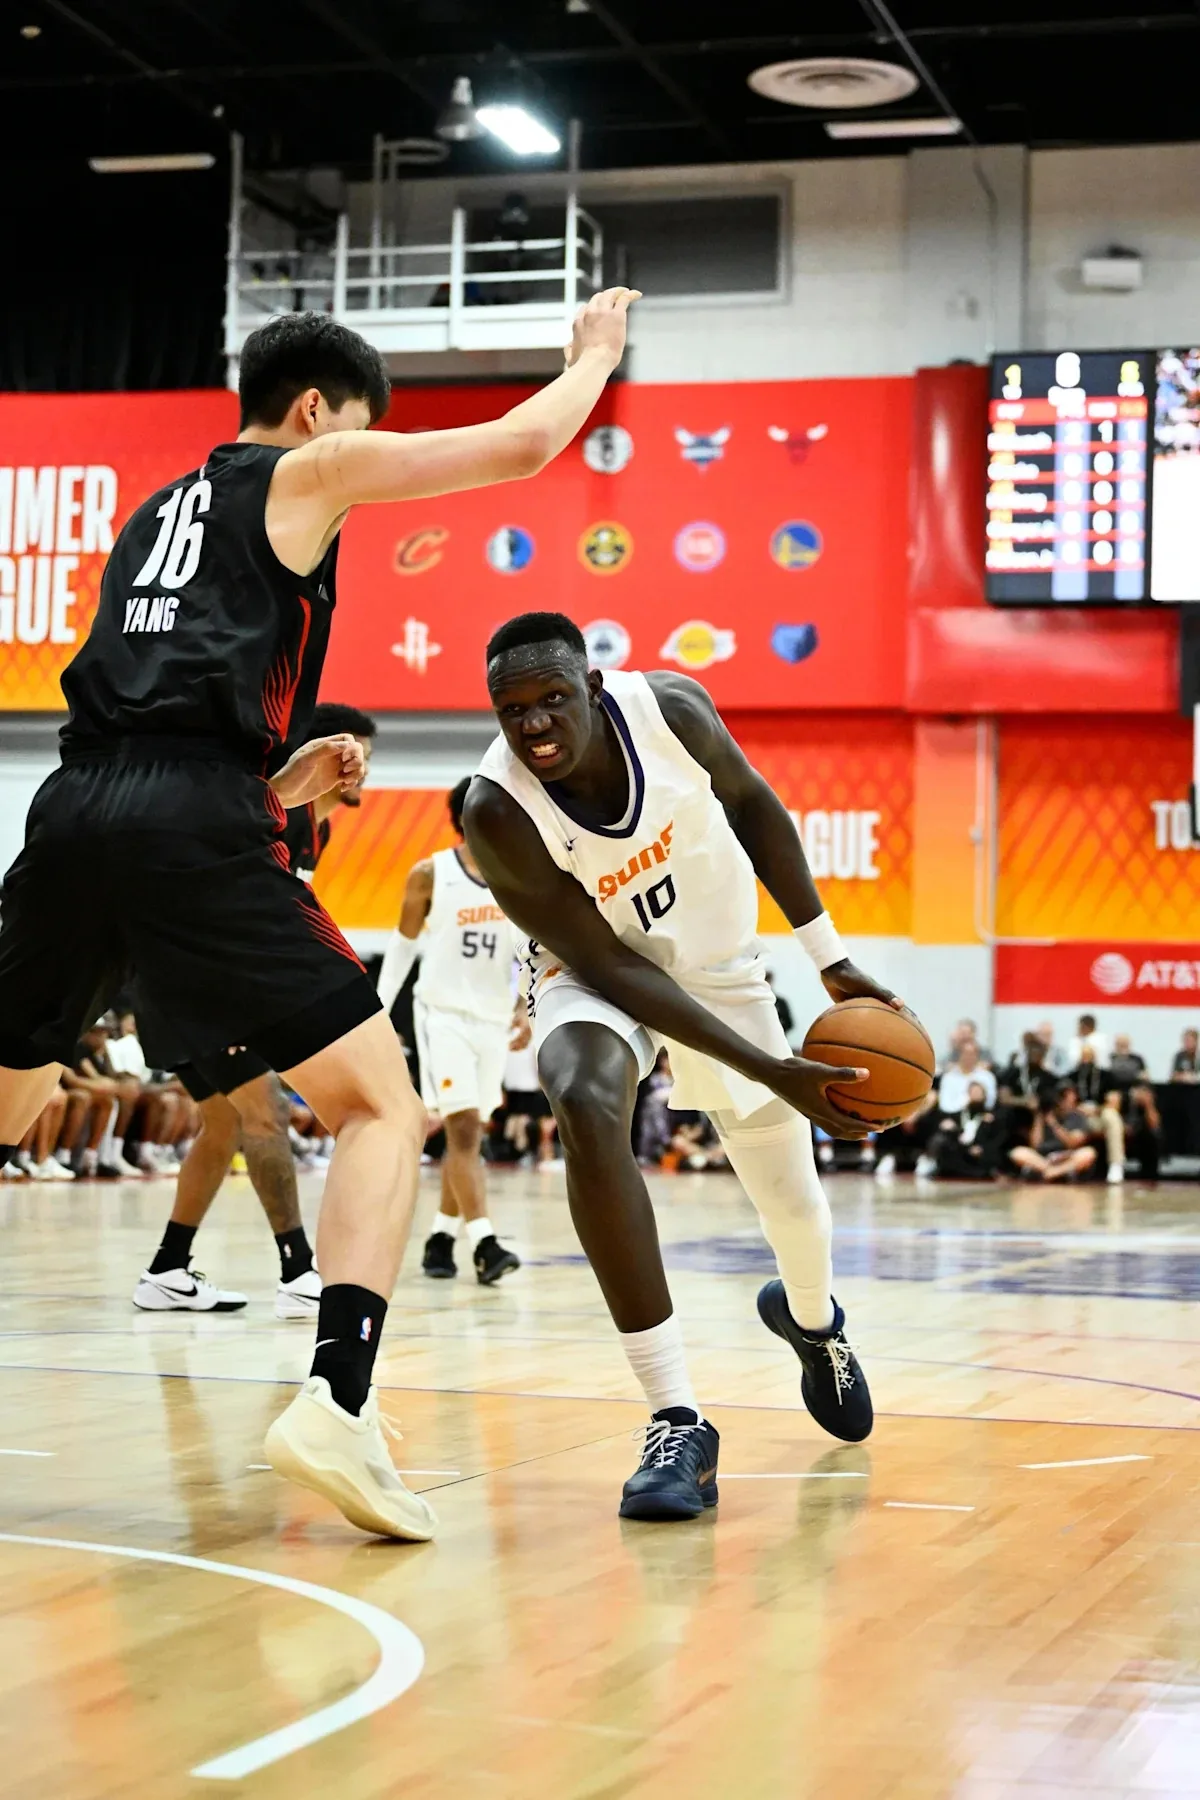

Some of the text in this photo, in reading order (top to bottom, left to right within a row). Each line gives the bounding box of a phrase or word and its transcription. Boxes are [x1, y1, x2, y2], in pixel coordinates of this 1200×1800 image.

[132, 480, 212, 589] 16
[122, 597, 180, 633] YANG
[631, 874, 676, 933] 10
[462, 930, 497, 958] 54
